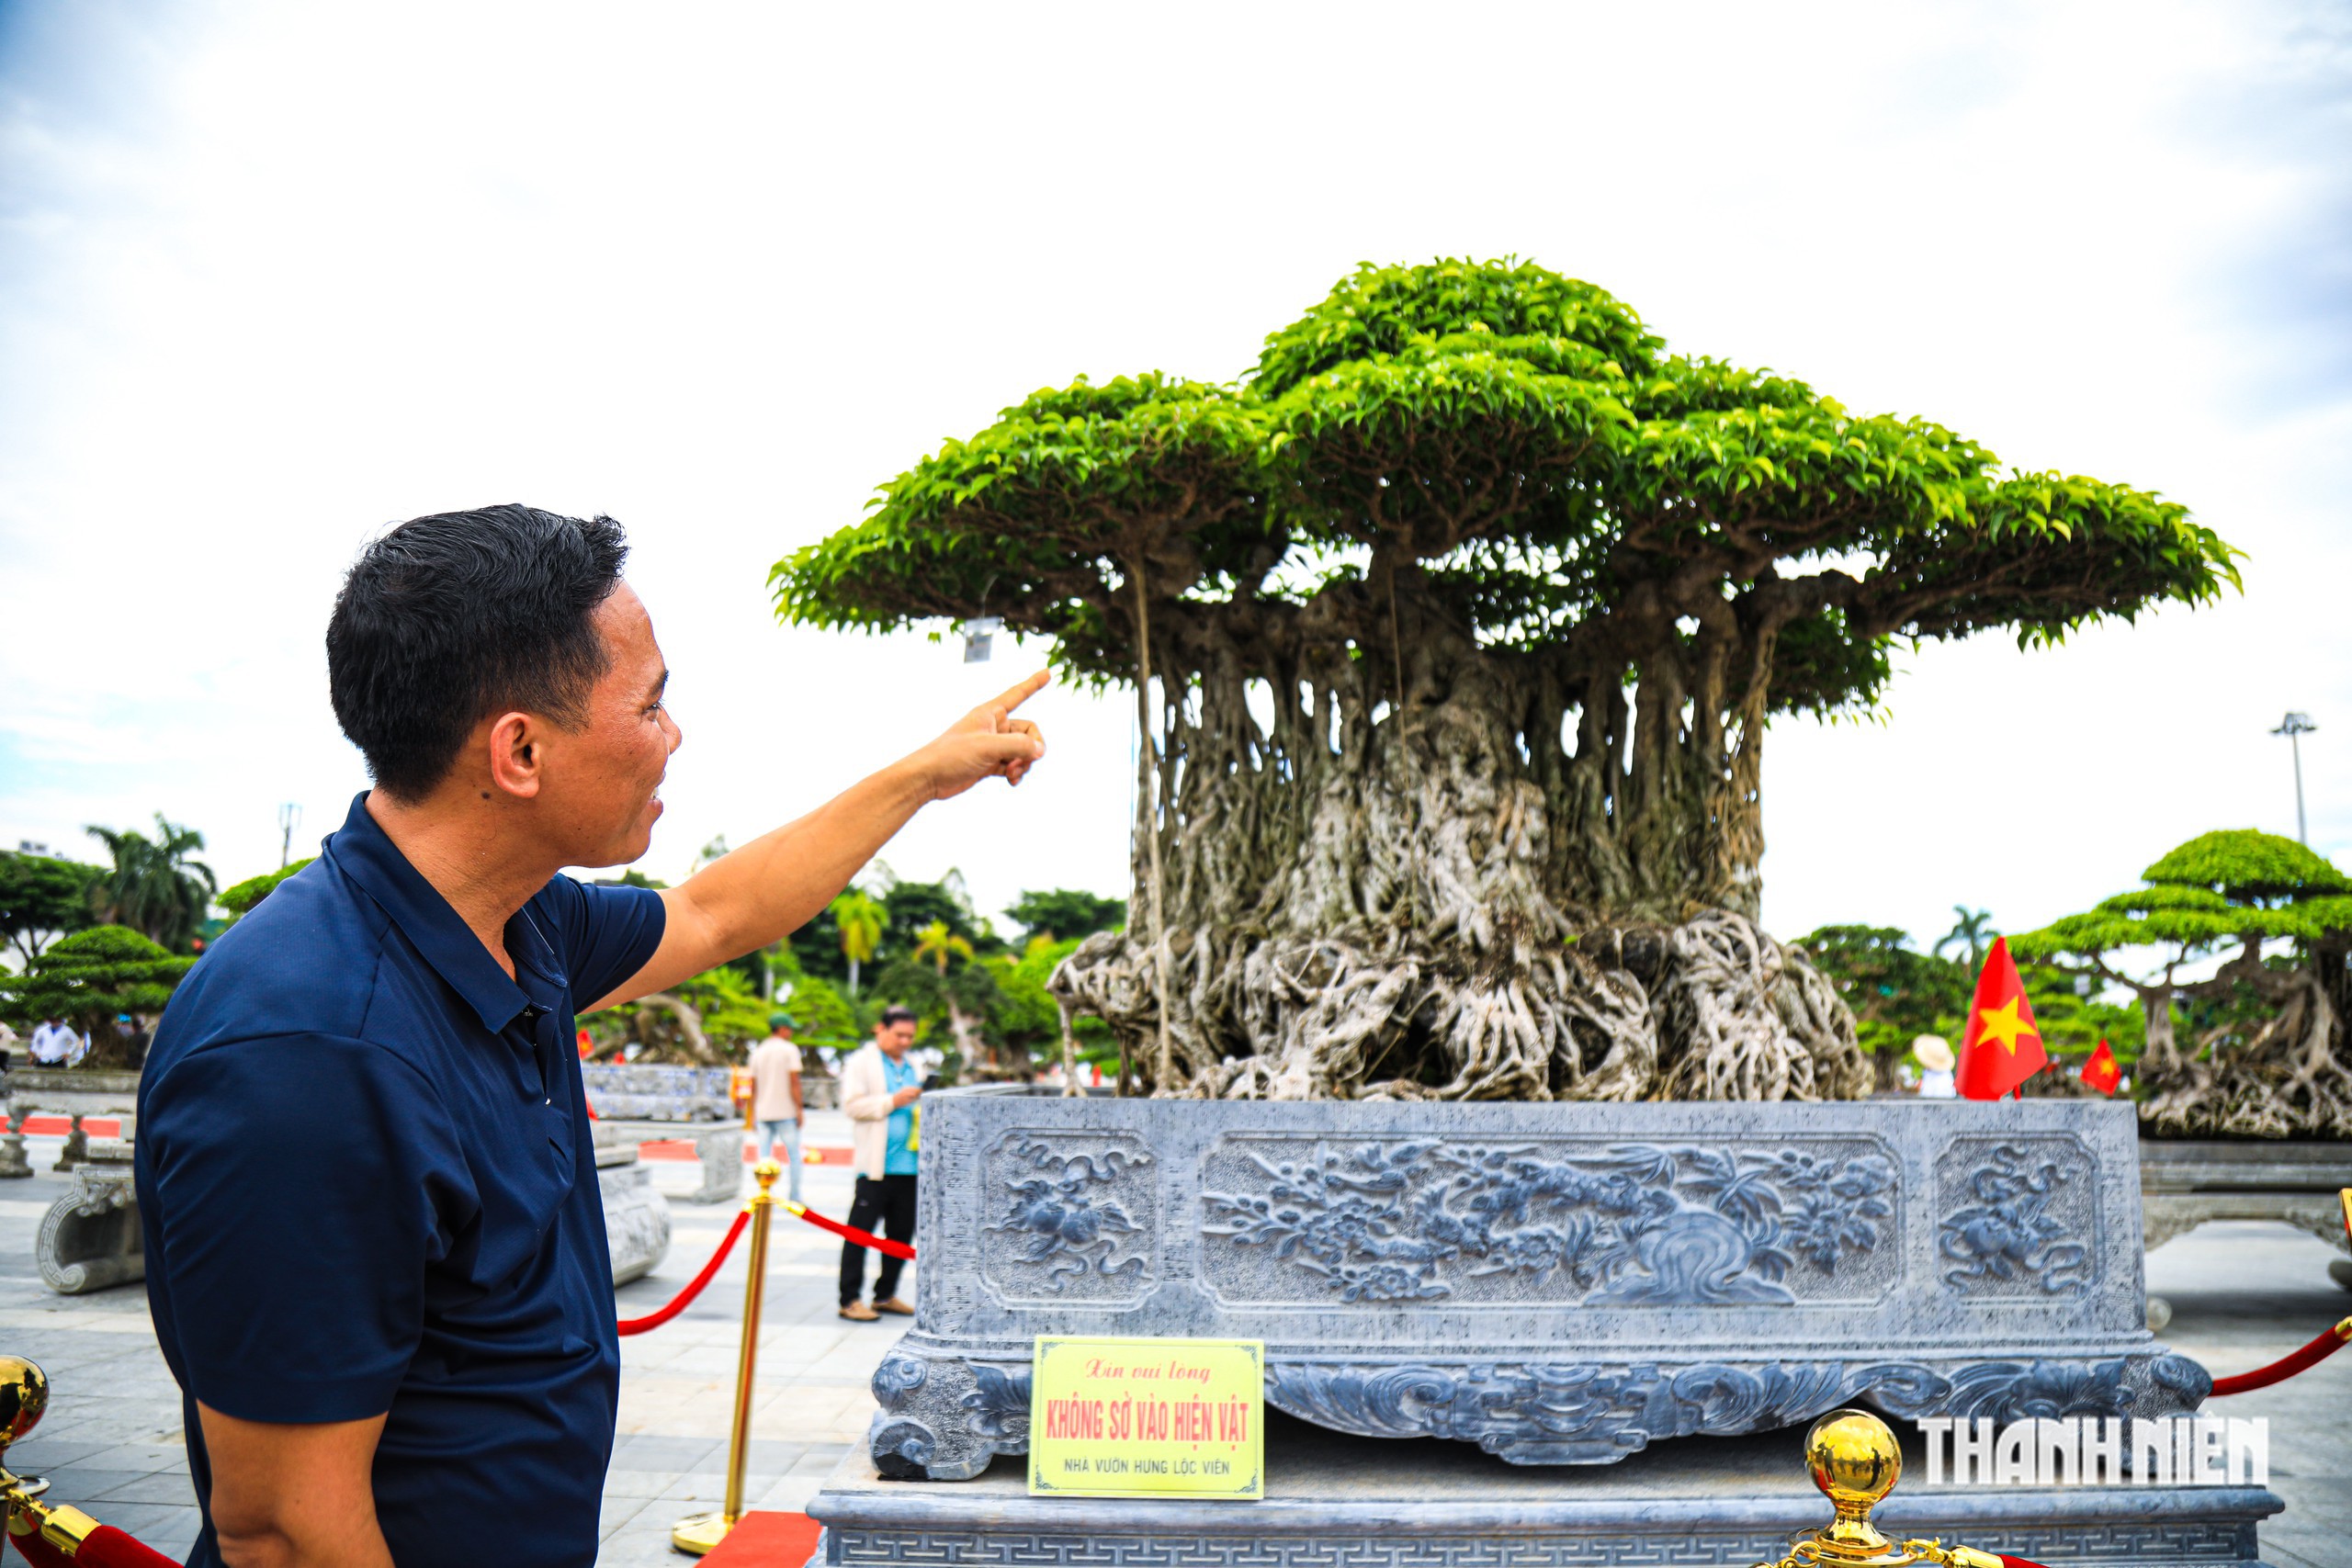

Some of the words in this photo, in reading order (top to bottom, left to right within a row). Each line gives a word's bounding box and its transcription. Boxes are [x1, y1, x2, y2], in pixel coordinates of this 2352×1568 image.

[1086, 1359, 1125, 1379] Xin
[1132, 1363, 1162, 1379] vui
[1169, 1360, 1211, 1384] lòng
[1046, 1392, 1103, 1439] KHÔNG
[1109, 1391, 1132, 1440] SỜ
[1136, 1393, 1168, 1440] VÀO
[1174, 1393, 1213, 1451] HIỆN
[1218, 1393, 1249, 1451] VẬT
[1065, 1457, 1090, 1472] NHÀ
[1095, 1457, 1128, 1473] VƯỜN
[1135, 1459, 1168, 1474] HƯNG
[1174, 1458, 1197, 1476] LỘC
